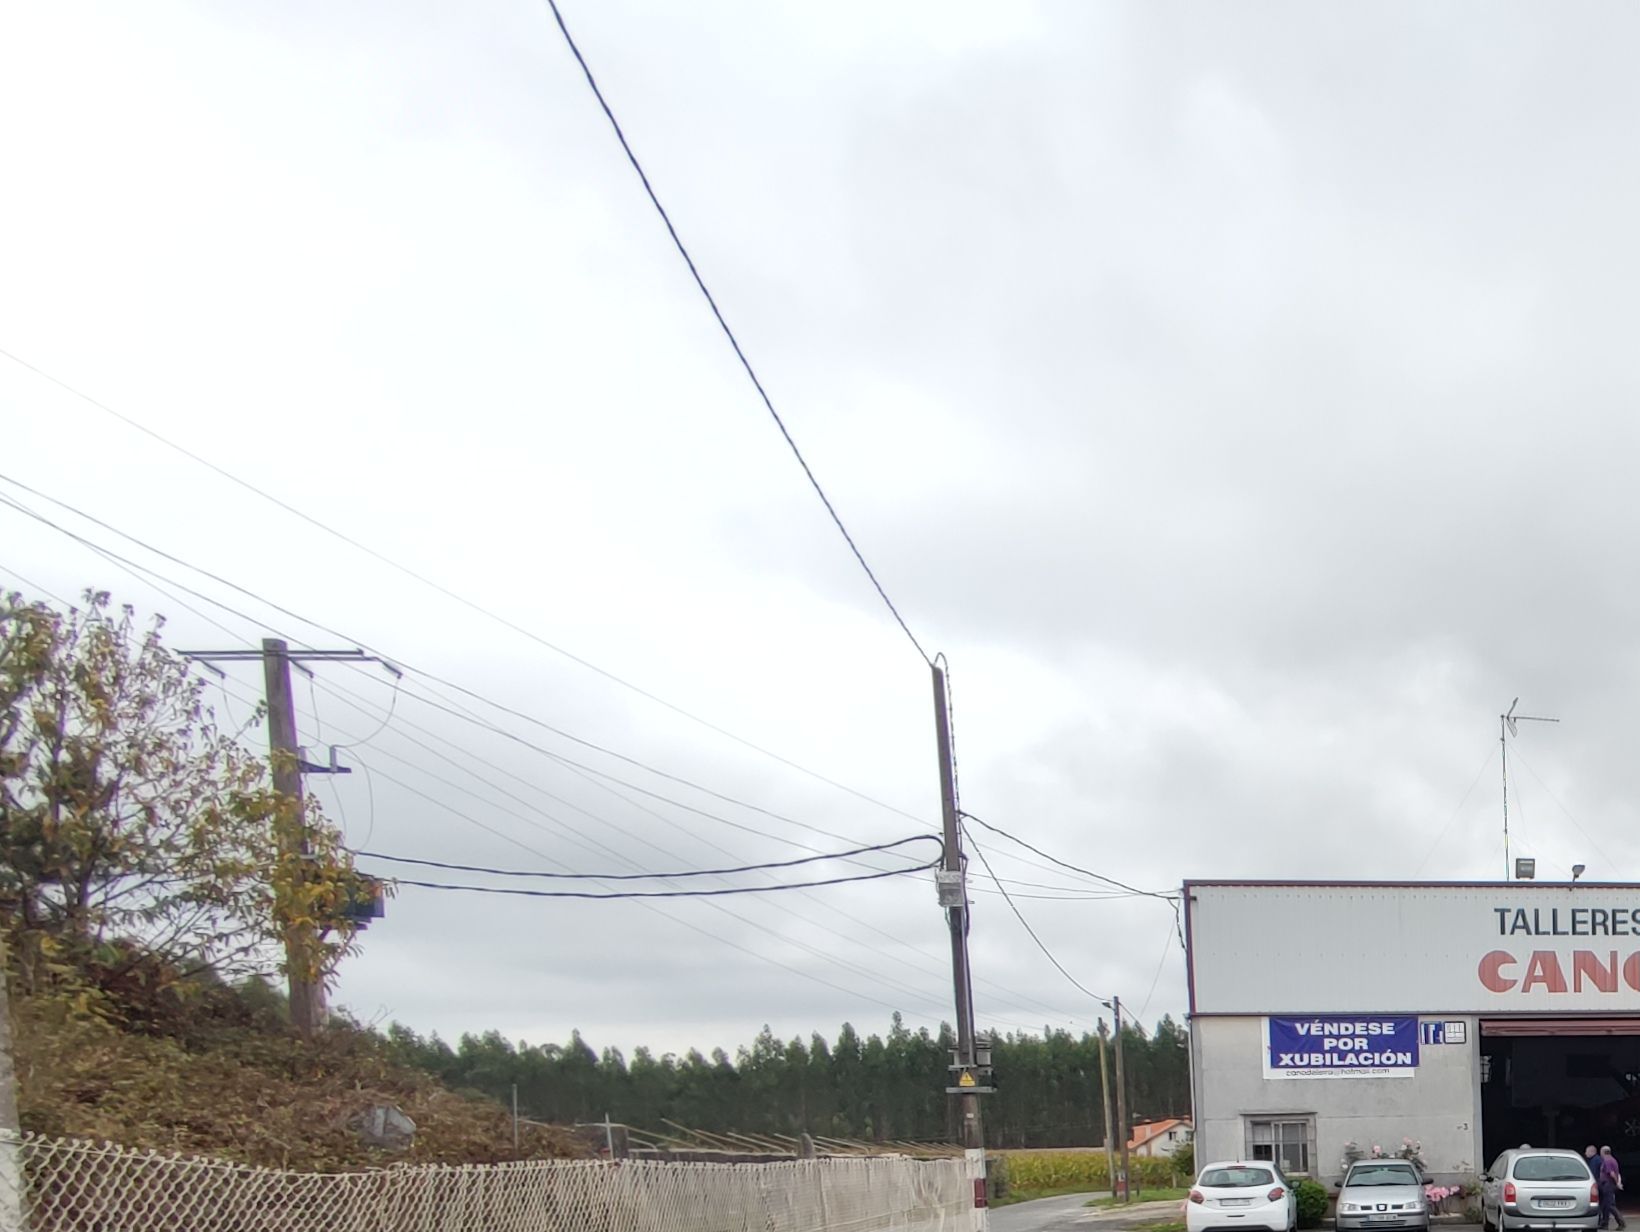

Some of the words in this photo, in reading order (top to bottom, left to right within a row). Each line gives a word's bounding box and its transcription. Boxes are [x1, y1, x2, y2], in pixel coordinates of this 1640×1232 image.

[1294, 1019, 1395, 1036] VÉNDESE
[1323, 1038, 1369, 1050] POR
[1278, 1049, 1412, 1066] XUBILACIÓN
